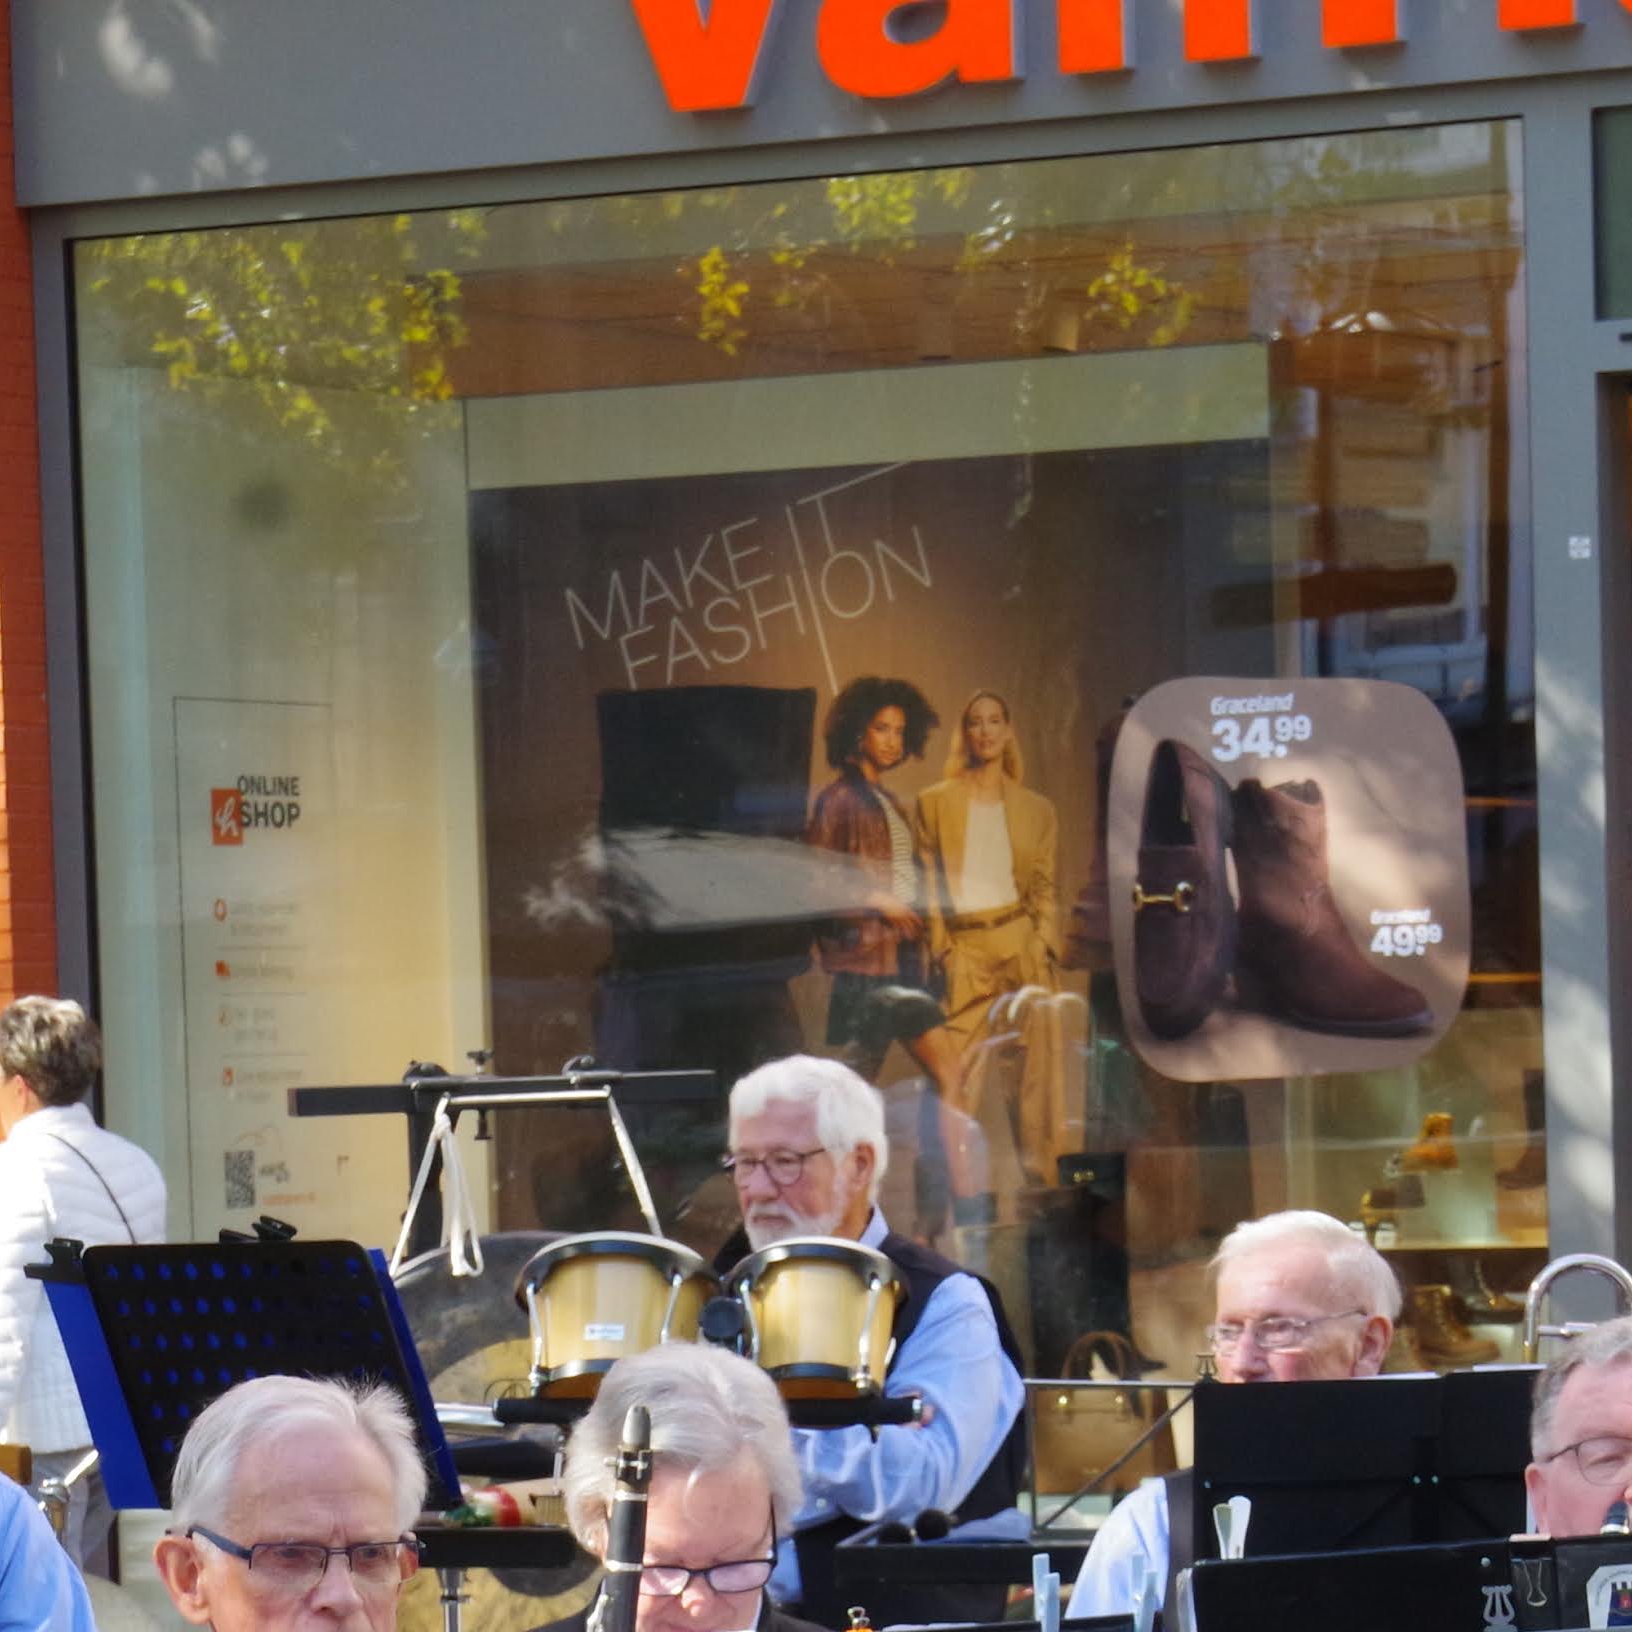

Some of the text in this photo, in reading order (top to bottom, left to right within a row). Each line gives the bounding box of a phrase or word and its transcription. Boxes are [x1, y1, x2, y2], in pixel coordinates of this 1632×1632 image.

[564, 516, 776, 651] MAKE
[618, 505, 933, 698] FASHION
[237, 775, 301, 797] ONLINE
[239, 801, 301, 829] SHOP
